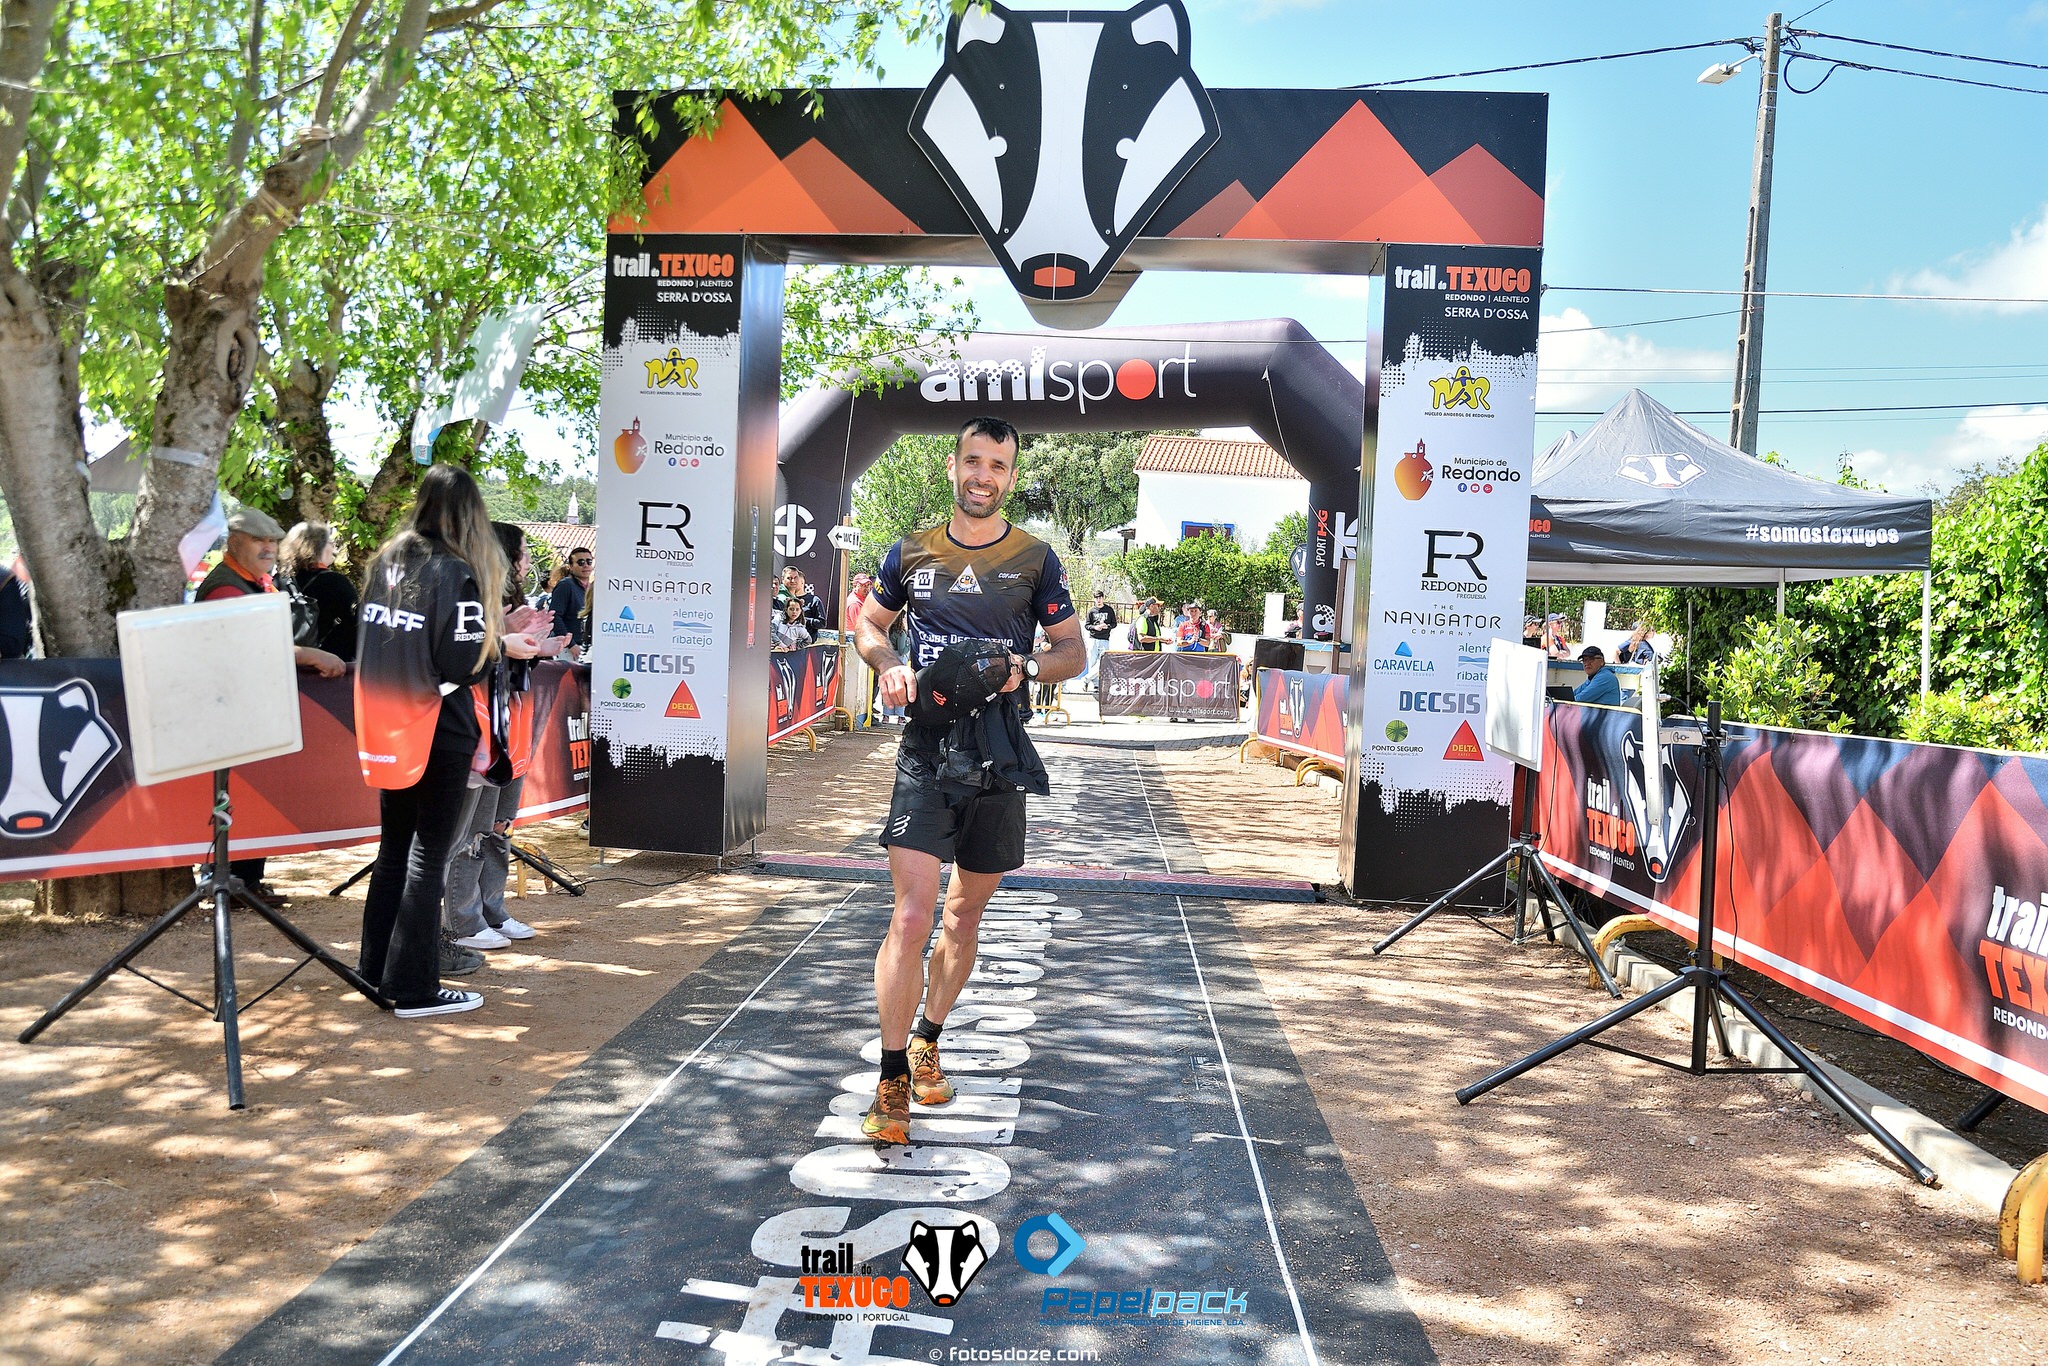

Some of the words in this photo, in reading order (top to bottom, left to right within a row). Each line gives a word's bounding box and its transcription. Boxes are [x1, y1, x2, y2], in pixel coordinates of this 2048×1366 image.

[613, 253, 650, 278] trail
[659, 253, 735, 278] TEXUGO
[657, 279, 694, 288] REDONDO
[700, 279, 734, 288] ALENTEJO
[1395, 264, 1437, 291] trail
[1446, 265, 1532, 293] TEXUGO
[656, 291, 689, 303] SERRA
[692, 292, 733, 303] D'OSSA
[1444, 292, 1485, 303] REDONDO
[1492, 294, 1530, 304] ALENTEJO
[1443, 305, 1480, 319] SERRA
[1483, 308, 1529, 320] D'OSSA
[703, 434, 713, 443] de
[653, 440, 725, 457] Redondo
[1496, 458, 1508, 467] de
[1441, 465, 1521, 482] Redondo
[1745, 522, 1900, 548] #somostexugos
[635, 548, 695, 562] REDONDO
[609, 578, 713, 596] NAVIGATOR
[1420, 579, 1488, 595] REDONDO
[1433, 603, 1455, 611] THE
[363, 602, 426, 632] STAFF
[672, 607, 714, 623] alentejo
[1383, 609, 1502, 630] NAVIGATOR
[600, 620, 656, 635] CARAVELA
[1411, 628, 1474, 638] COMPANY
[454, 632, 487, 642] REDOND
[671, 634, 713, 649] ribatejo
[1458, 642, 1491, 655] alente
[623, 652, 695, 675] DECSIS
[1373, 658, 1435, 672] CARAVELA
[1456, 669, 1488, 683] ribate
[600, 700, 622, 708] PONTO
[622, 701, 646, 709] SEGURO
[671, 702, 695, 711] DELTA
[1399, 690, 1481, 714] DECSIS
[1396, 745, 1424, 753] SEGURO
[1452, 743, 1478, 752] DELTA
[1587, 777, 1610, 814] trail
[1586, 808, 1636, 856] TEXUGO
[1613, 855, 1635, 872] ALENTEJO
[1986, 885, 2048, 958] trai
[1979, 939, 2048, 1018] TEX
[1993, 1006, 2048, 1041] REDOND
